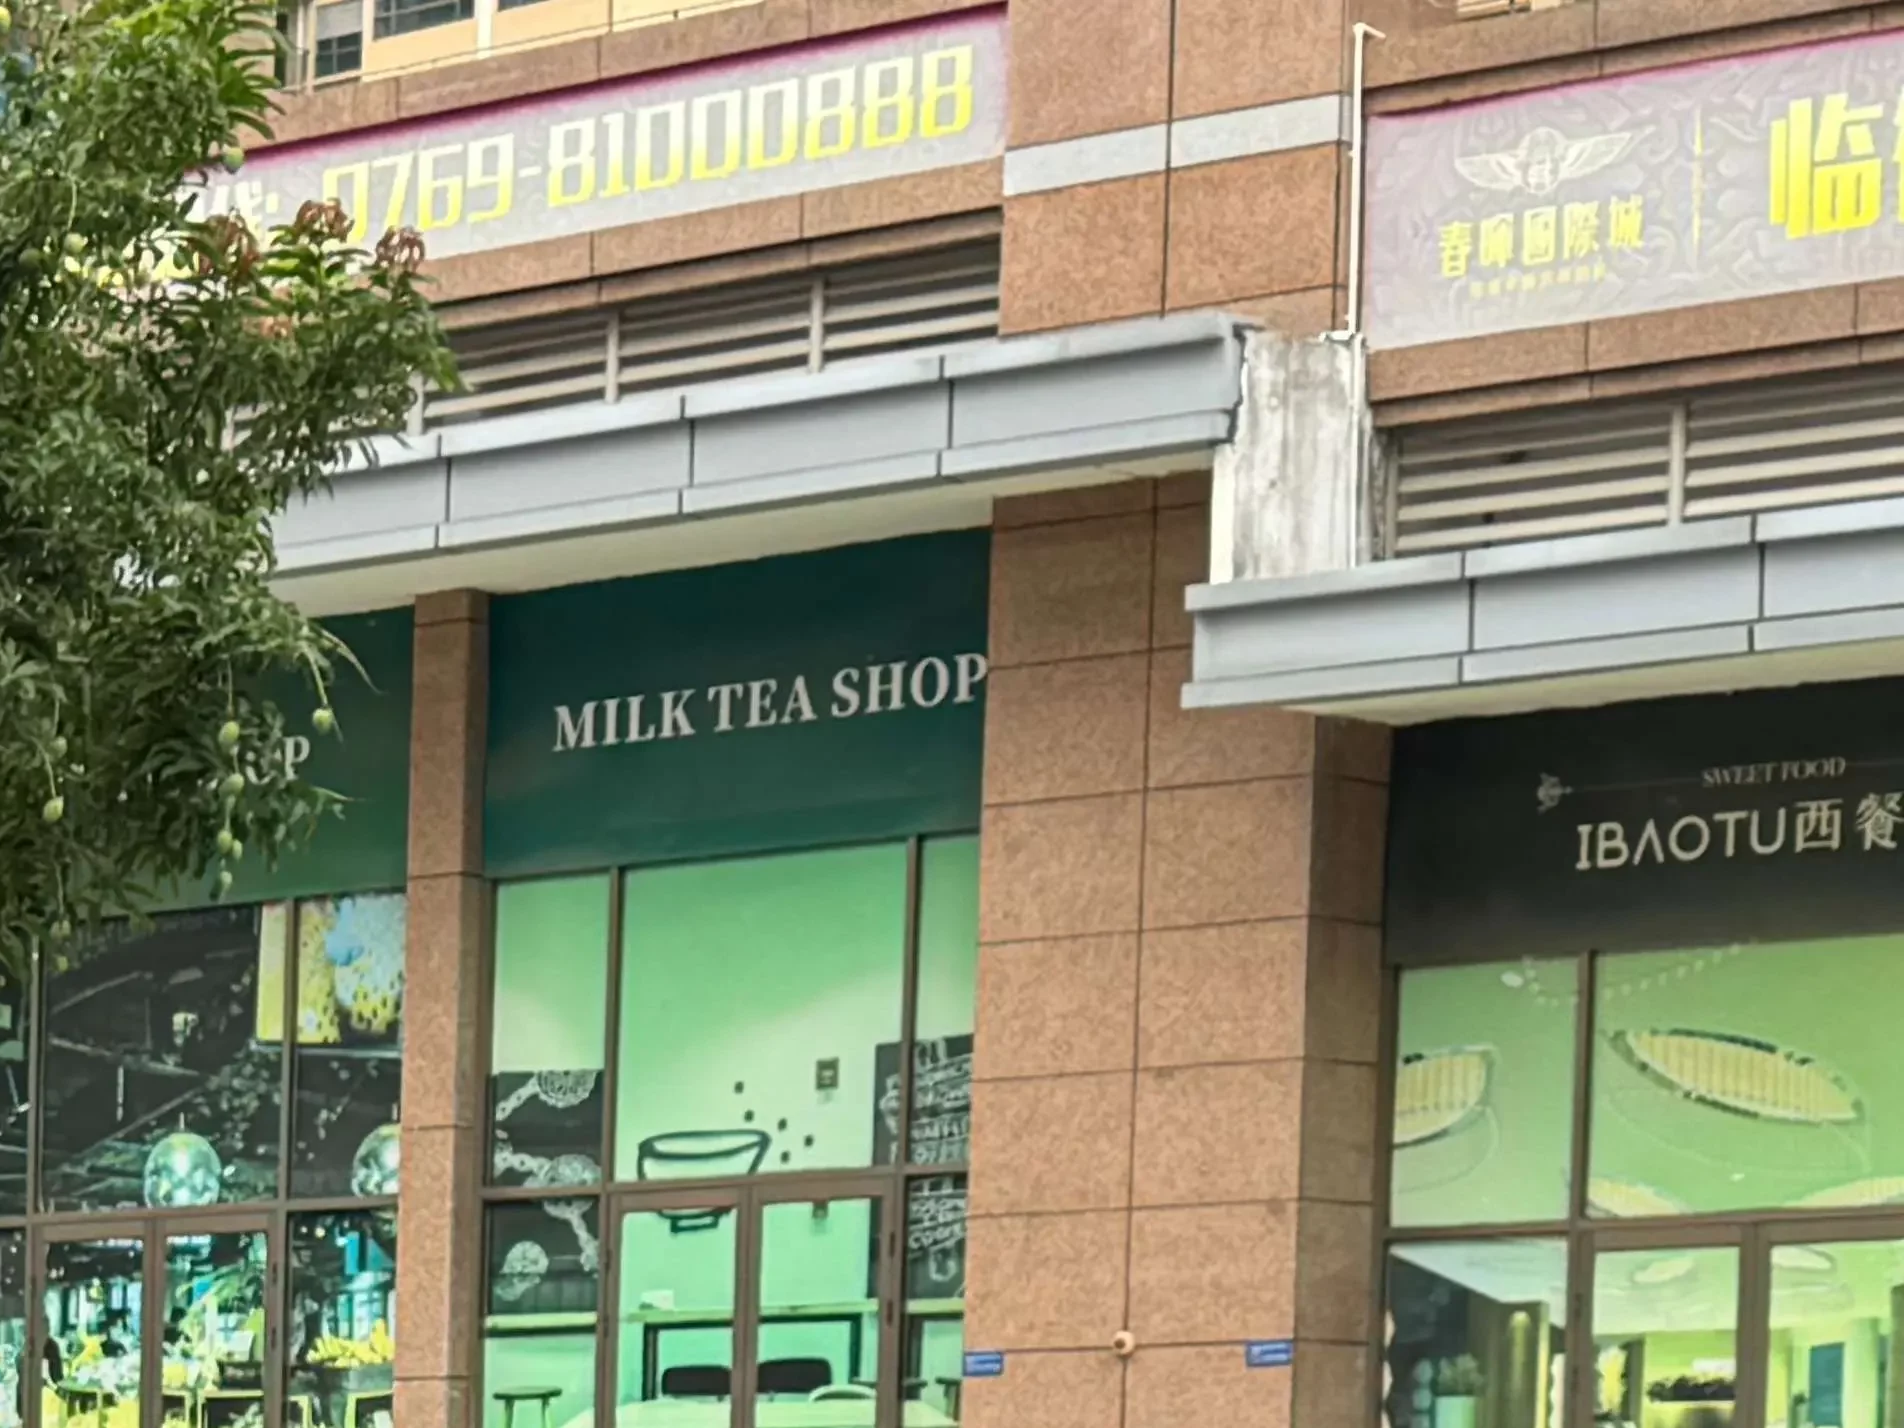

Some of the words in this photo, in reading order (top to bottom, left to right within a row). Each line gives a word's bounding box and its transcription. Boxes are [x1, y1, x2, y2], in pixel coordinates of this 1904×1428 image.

[552, 688, 698, 753] MILK
[707, 679, 817, 735] TEA
[830, 652, 988, 720] SHOP
[1702, 761, 1775, 788] SWEET
[1780, 757, 1846, 783] FOOD
